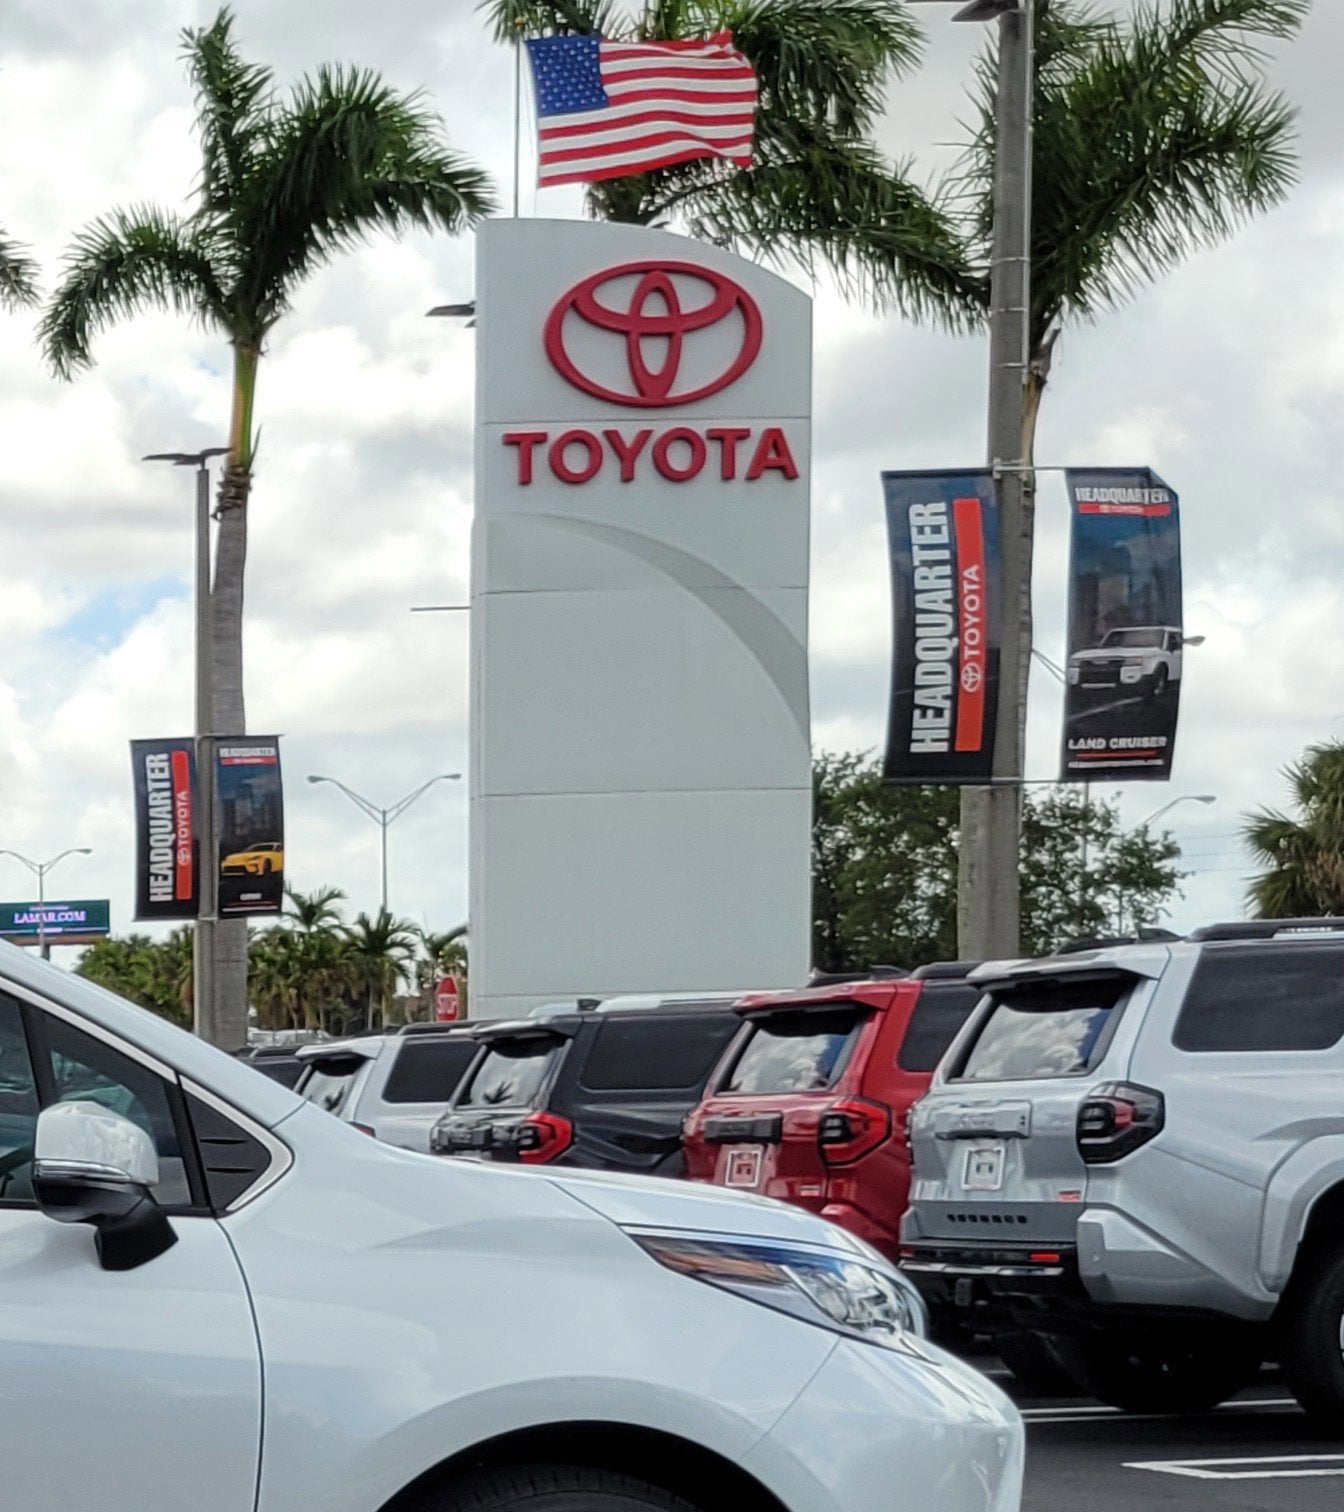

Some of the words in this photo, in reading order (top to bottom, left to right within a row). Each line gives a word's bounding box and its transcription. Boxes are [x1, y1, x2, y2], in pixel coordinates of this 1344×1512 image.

[502, 427, 799, 485] TOYOTA
[1075, 487, 1170, 505] HEADQUARTER
[909, 501, 958, 754] HEADQUARTER
[962, 564, 982, 660] TOYOTA
[1068, 737, 1107, 750] LAND
[1109, 736, 1168, 749] CRUISER
[146, 753, 175, 902] HEADQUARTER
[176, 790, 191, 847] TOYOTA
[13, 911, 87, 924] LAMAR.COM
